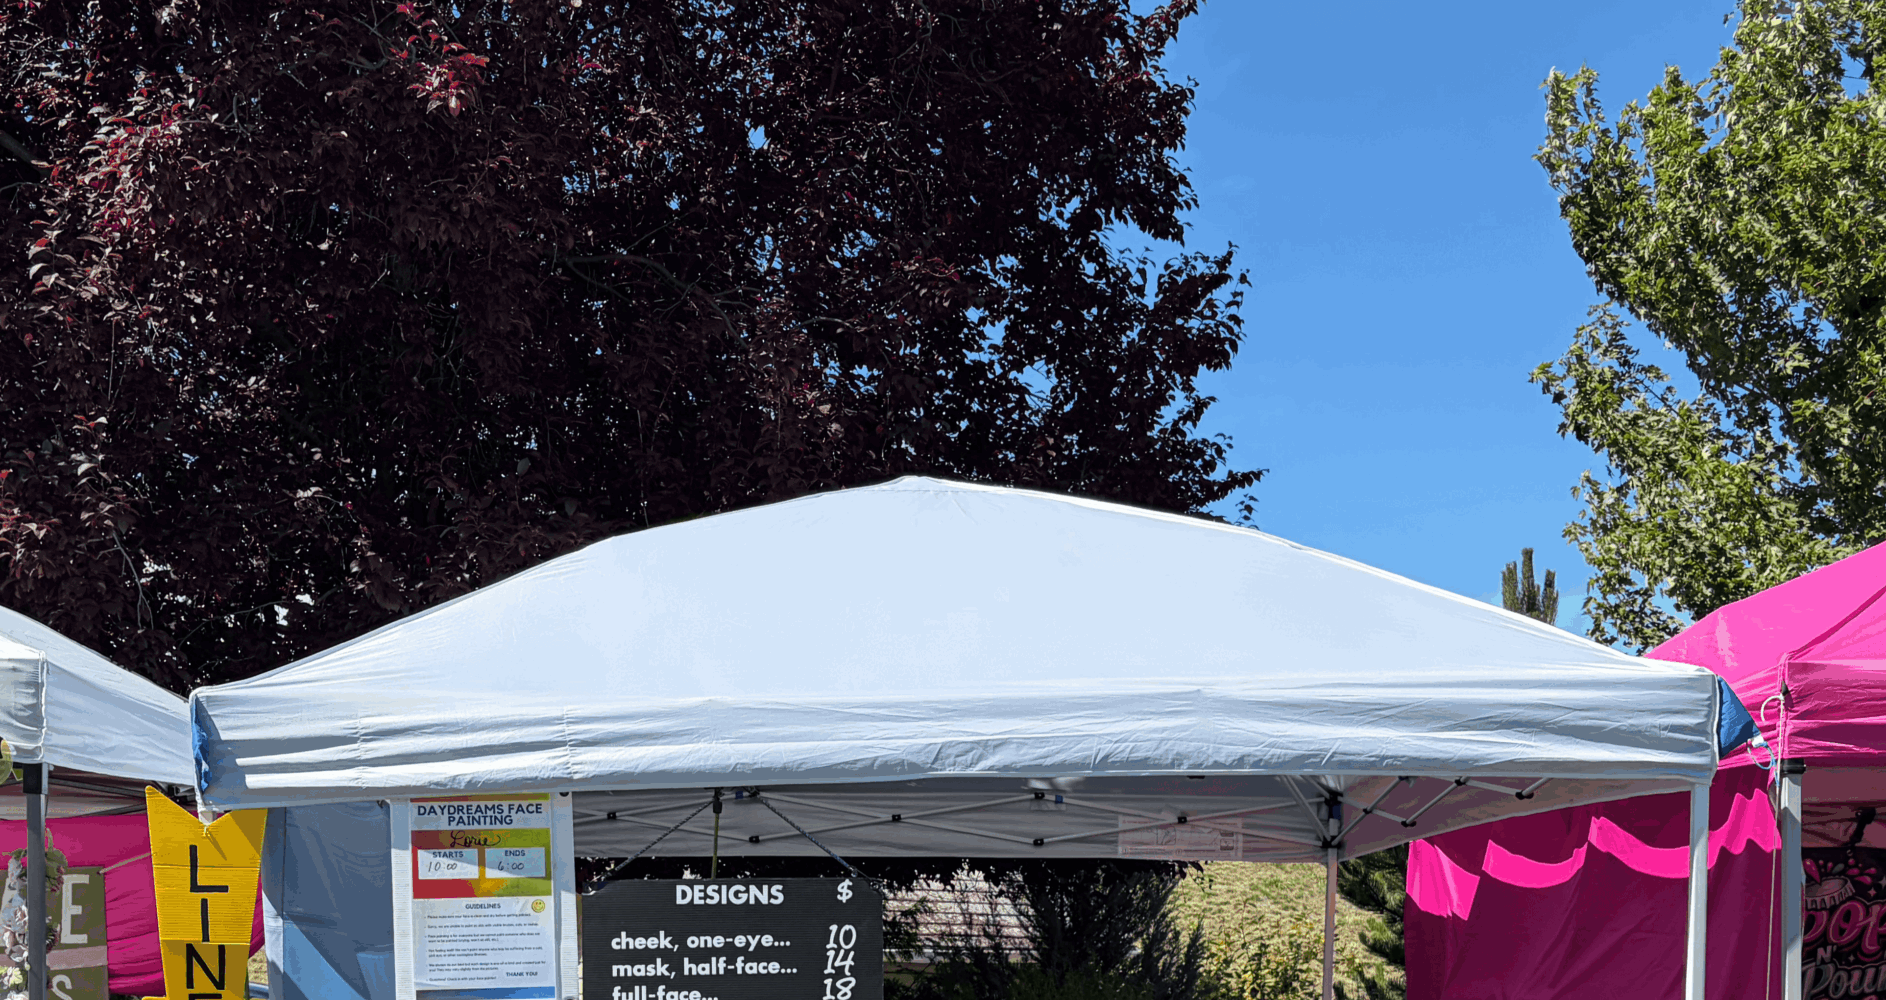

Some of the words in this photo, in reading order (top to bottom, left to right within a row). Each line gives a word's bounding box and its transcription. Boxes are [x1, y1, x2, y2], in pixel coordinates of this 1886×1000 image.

[417, 804, 504, 816] DAYDREAMS
[507, 803, 543, 814] FACE
[448, 815, 513, 826] PAINTING
[450, 830, 501, 847] Lorie
[498, 861, 525, 872] 6:00
[676, 885, 784, 904] DESIGNS
[837, 879, 852, 903] $
[611, 931, 679, 952] cheek,
[687, 935, 790, 952] one-eye...
[826, 925, 857, 949] 10
[611, 958, 676, 979] mask,
[684, 956, 797, 975] half-face...
[824, 950, 854, 975] 14
[823, 977, 856, 1000] 18
